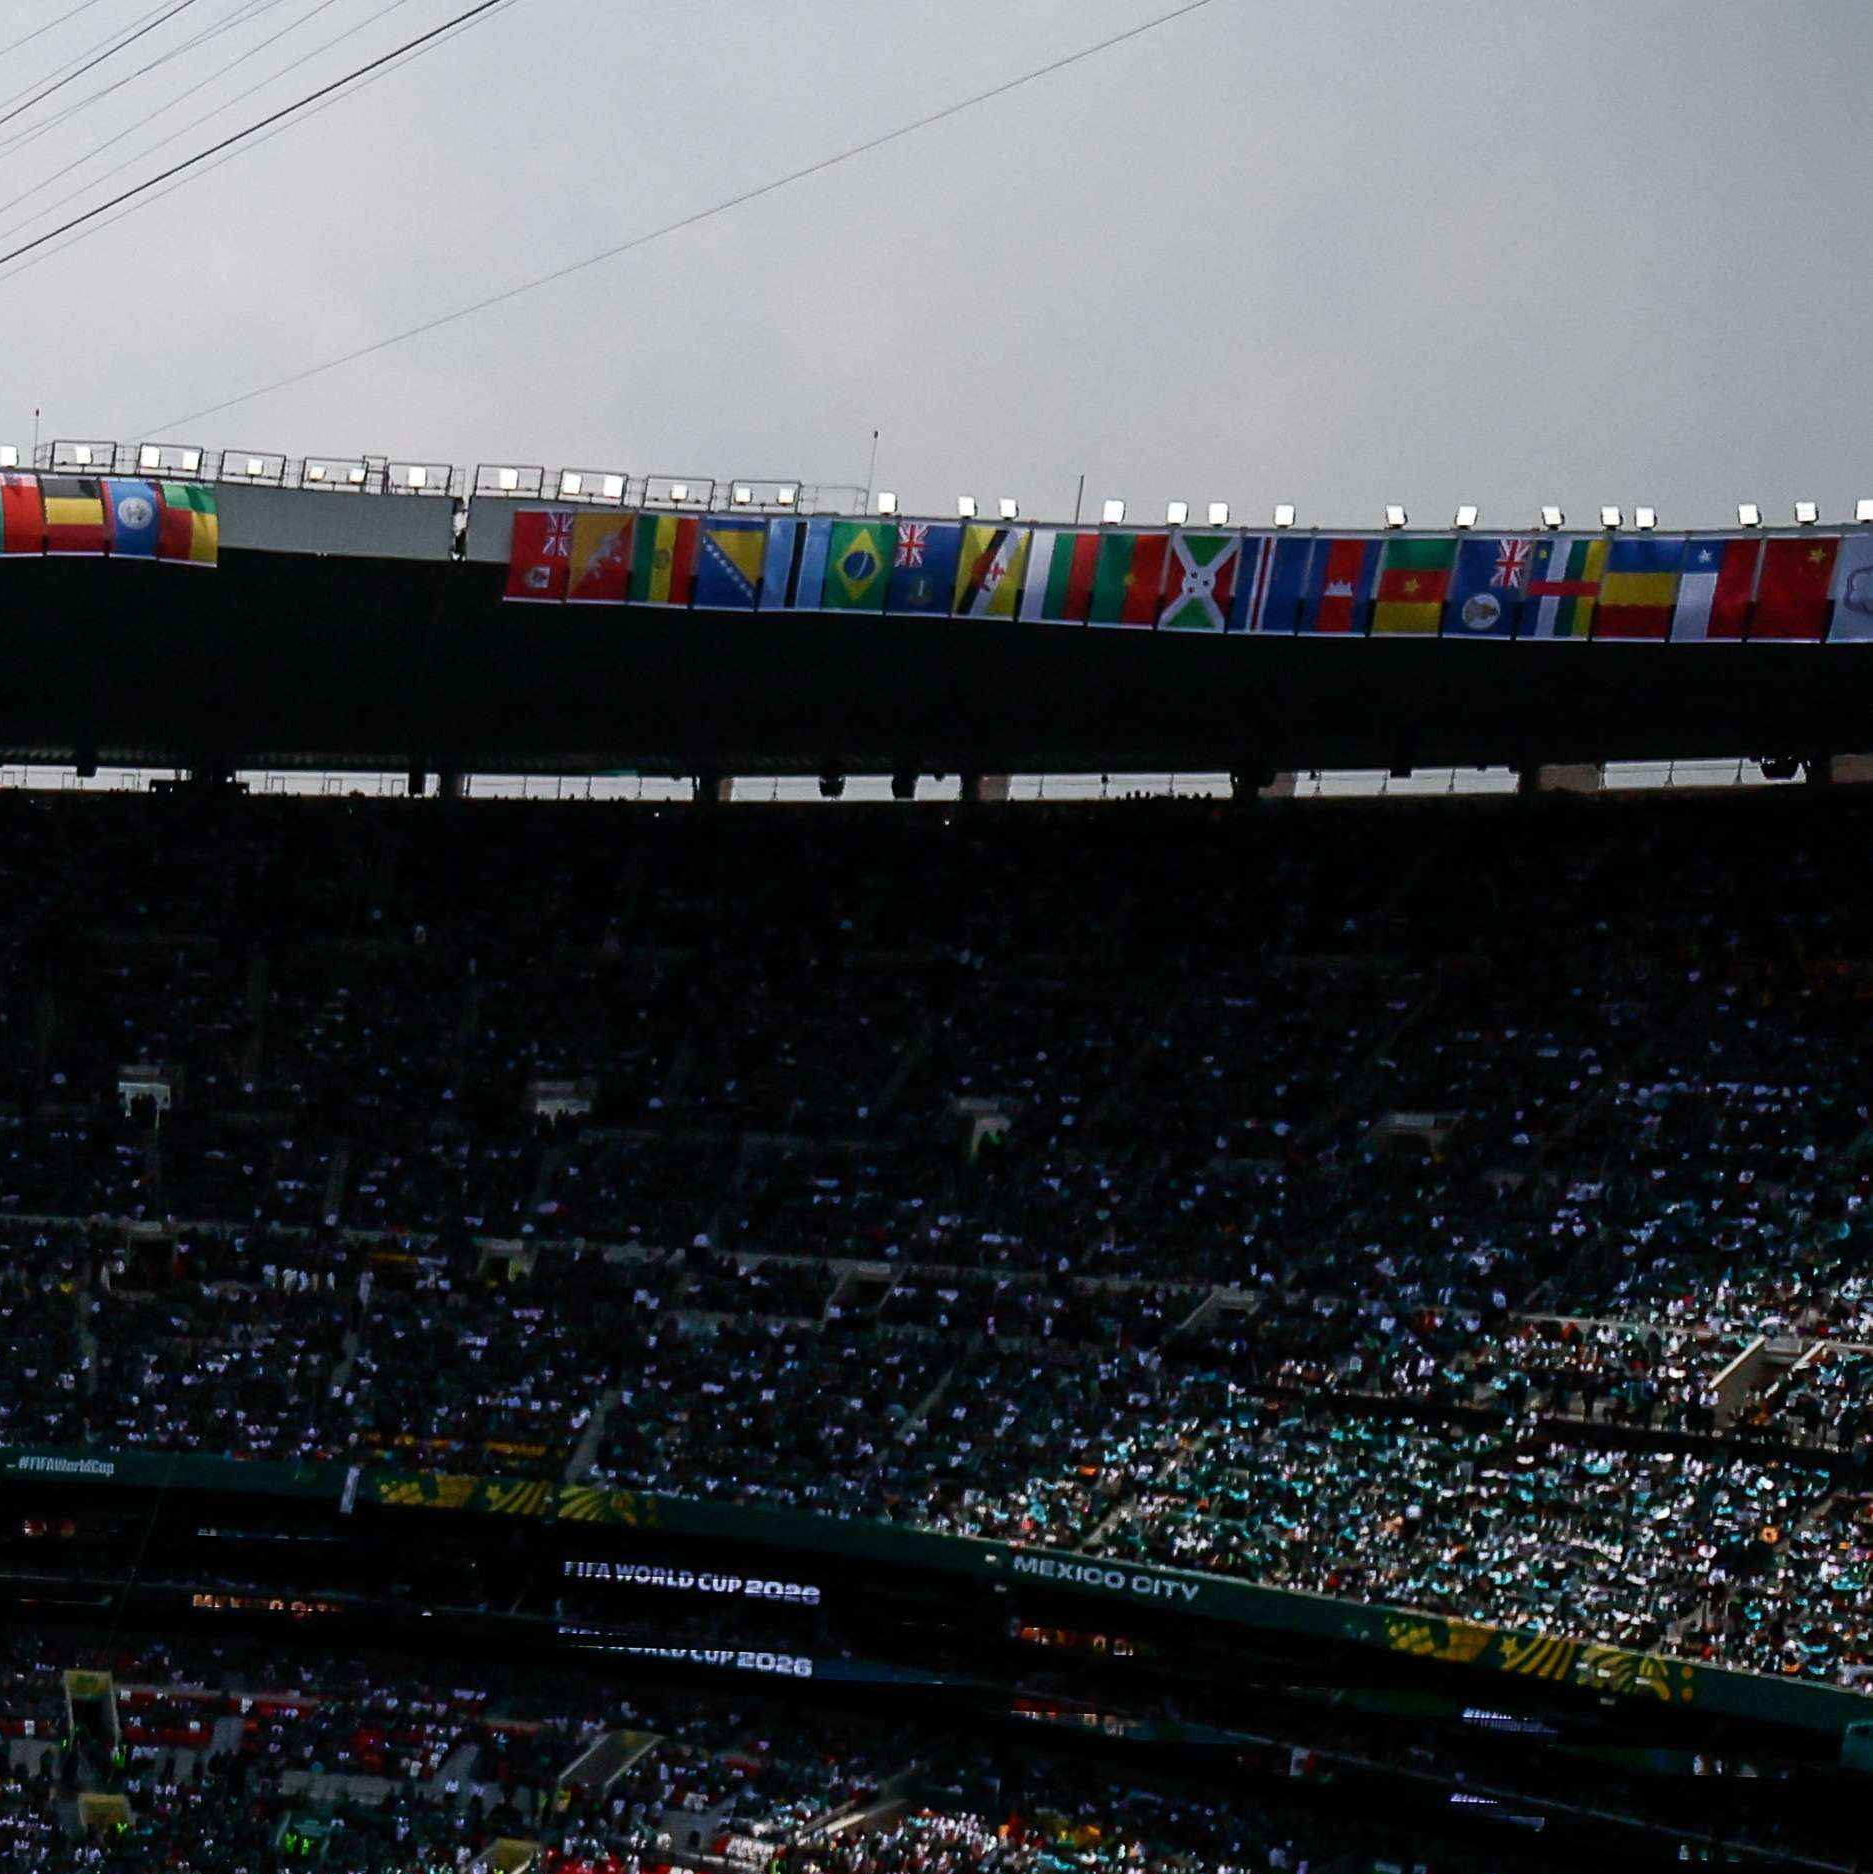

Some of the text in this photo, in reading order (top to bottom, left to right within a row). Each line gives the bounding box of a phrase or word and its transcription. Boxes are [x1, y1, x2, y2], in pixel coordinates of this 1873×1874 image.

[565, 1560, 822, 1607] FIFA WORLD CUP 2026
[1013, 1554, 1201, 1603] MEXICO CITY
